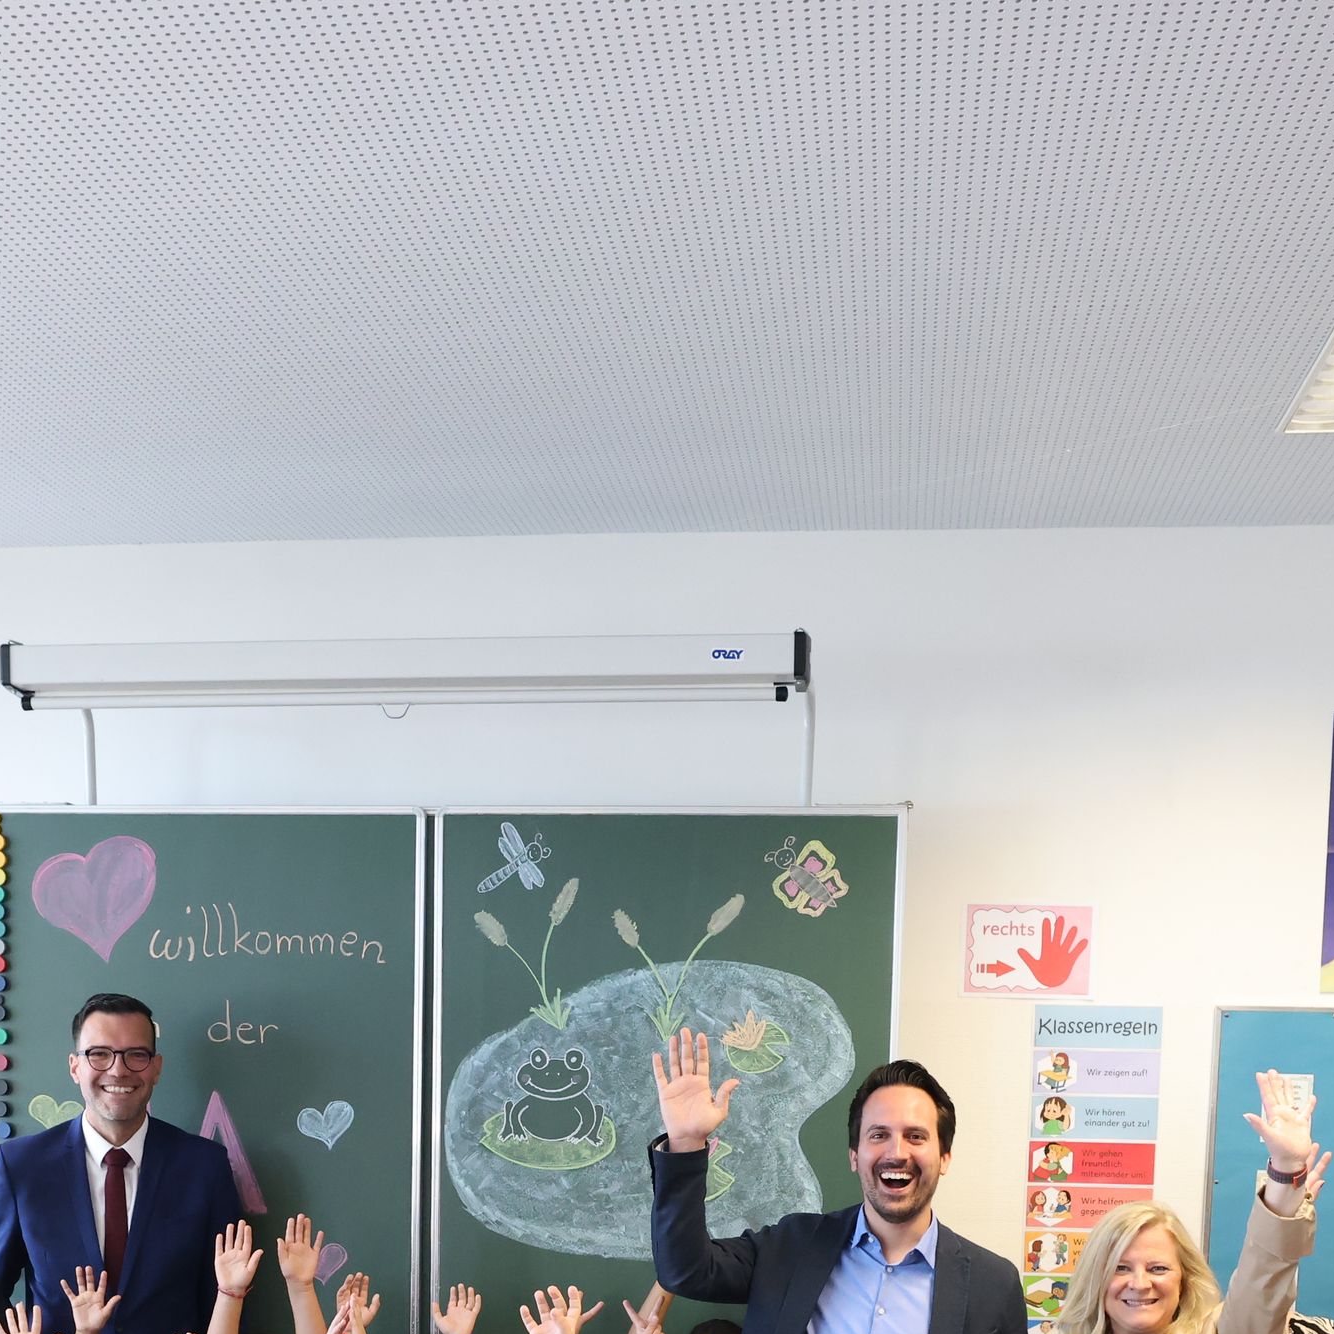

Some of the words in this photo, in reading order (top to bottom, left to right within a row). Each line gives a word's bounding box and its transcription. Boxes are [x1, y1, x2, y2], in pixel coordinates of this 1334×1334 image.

[148, 902, 386, 964] willkommen
[982, 920, 1035, 937] rechts
[207, 999, 279, 1044] der
[1038, 1017, 1158, 1037] Klassenregeln
[1087, 1068, 1102, 1076] Wir
[1103, 1068, 1130, 1078] zeigen
[1131, 1068, 1148, 1077] auf!
[1085, 1108, 1100, 1116] Wir
[1102, 1108, 1126, 1116] hören
[1084, 1119, 1119, 1127] einander
[1121, 1120, 1135, 1129] gut
[1137, 1120, 1150, 1128] zu!
[1082, 1149, 1097, 1157] Wir
[1099, 1150, 1123, 1158] gehen
[1081, 1160, 1123, 1168] freundlich
[1080, 1170, 1128, 1178] miteinander
[1081, 1197, 1097, 1205] Wir
[1098, 1197, 1124, 1205] helfen
